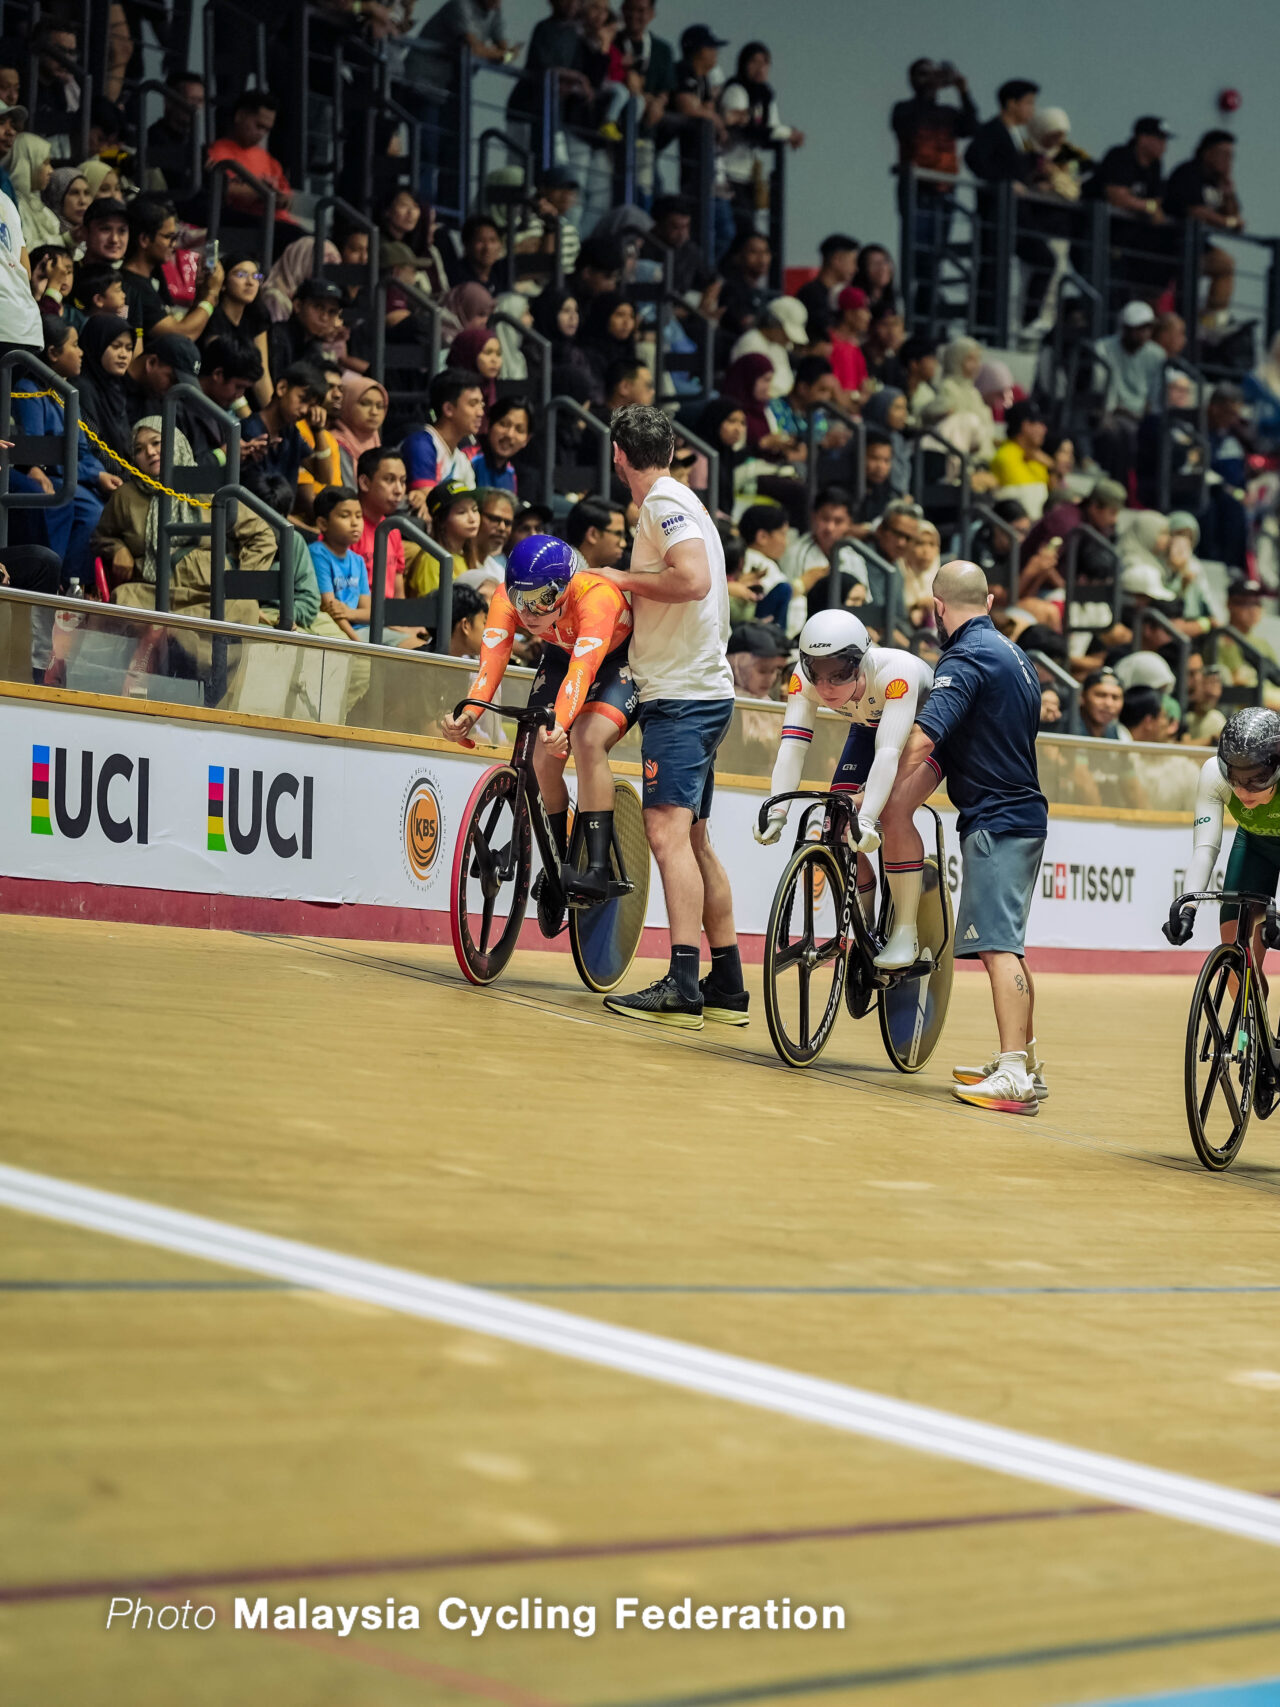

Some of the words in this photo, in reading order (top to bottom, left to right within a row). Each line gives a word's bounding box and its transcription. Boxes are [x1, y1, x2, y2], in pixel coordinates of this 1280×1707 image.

[54, 747, 150, 845] UCI
[228, 767, 314, 860] UCI
[415, 816, 435, 841] KBS
[840, 866, 857, 936] LOTUS
[1070, 864, 1135, 902] TISSOT
